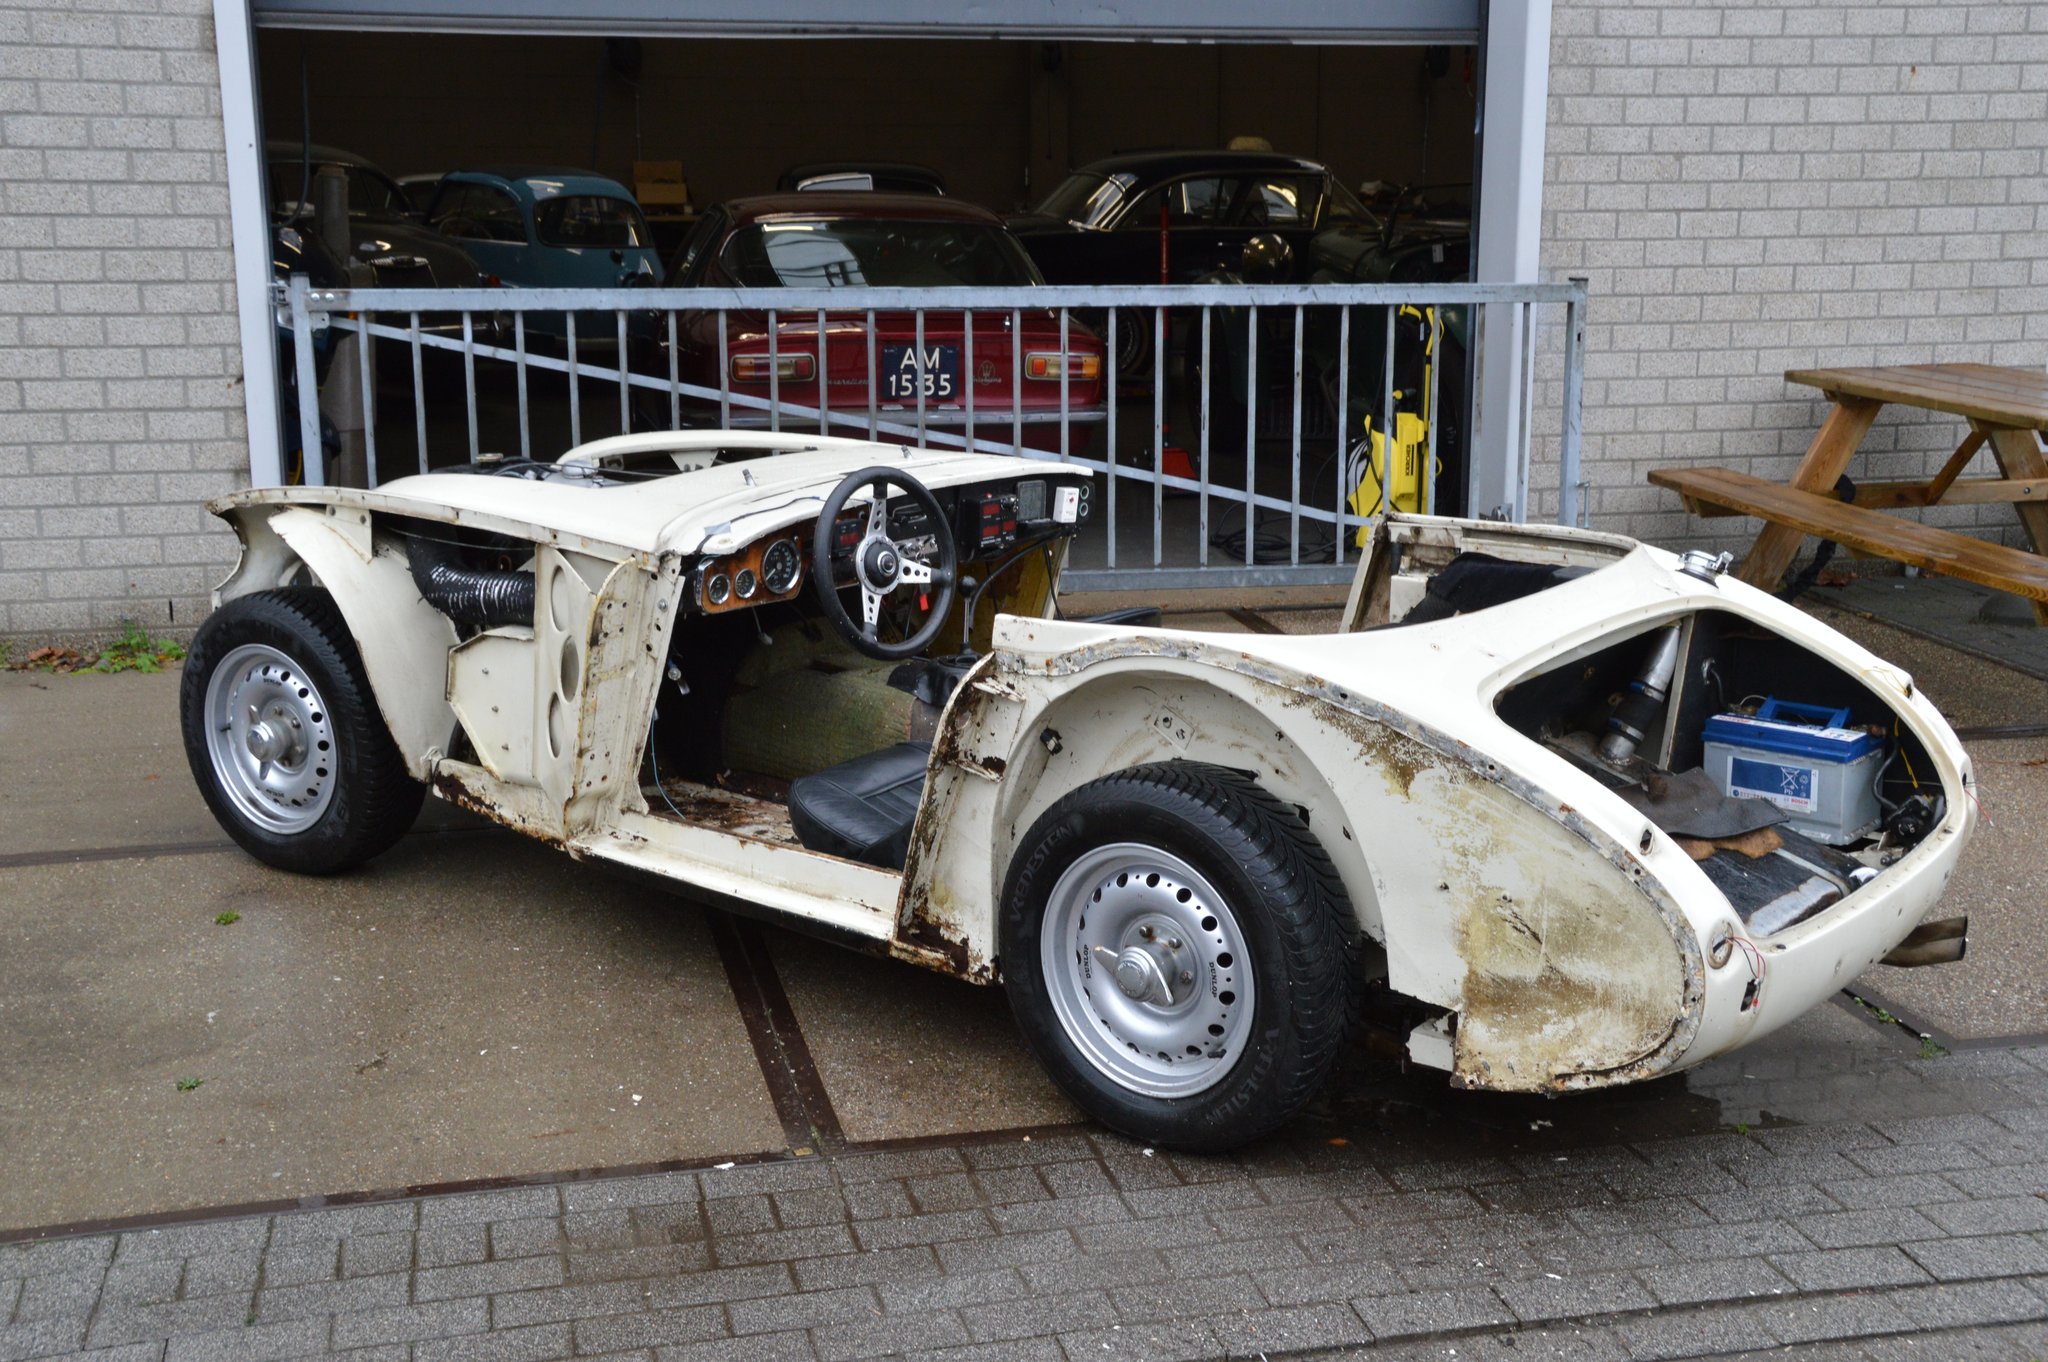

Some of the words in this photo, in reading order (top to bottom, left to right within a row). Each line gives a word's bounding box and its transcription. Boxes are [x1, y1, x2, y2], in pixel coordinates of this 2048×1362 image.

[900, 347, 940, 370] AM
[889, 374, 951, 396] 1535
[1010, 822, 1075, 922] VREDESTEIN
[1083, 944, 1092, 979] DUNLOP
[1208, 961, 1218, 998] DUNLOP
